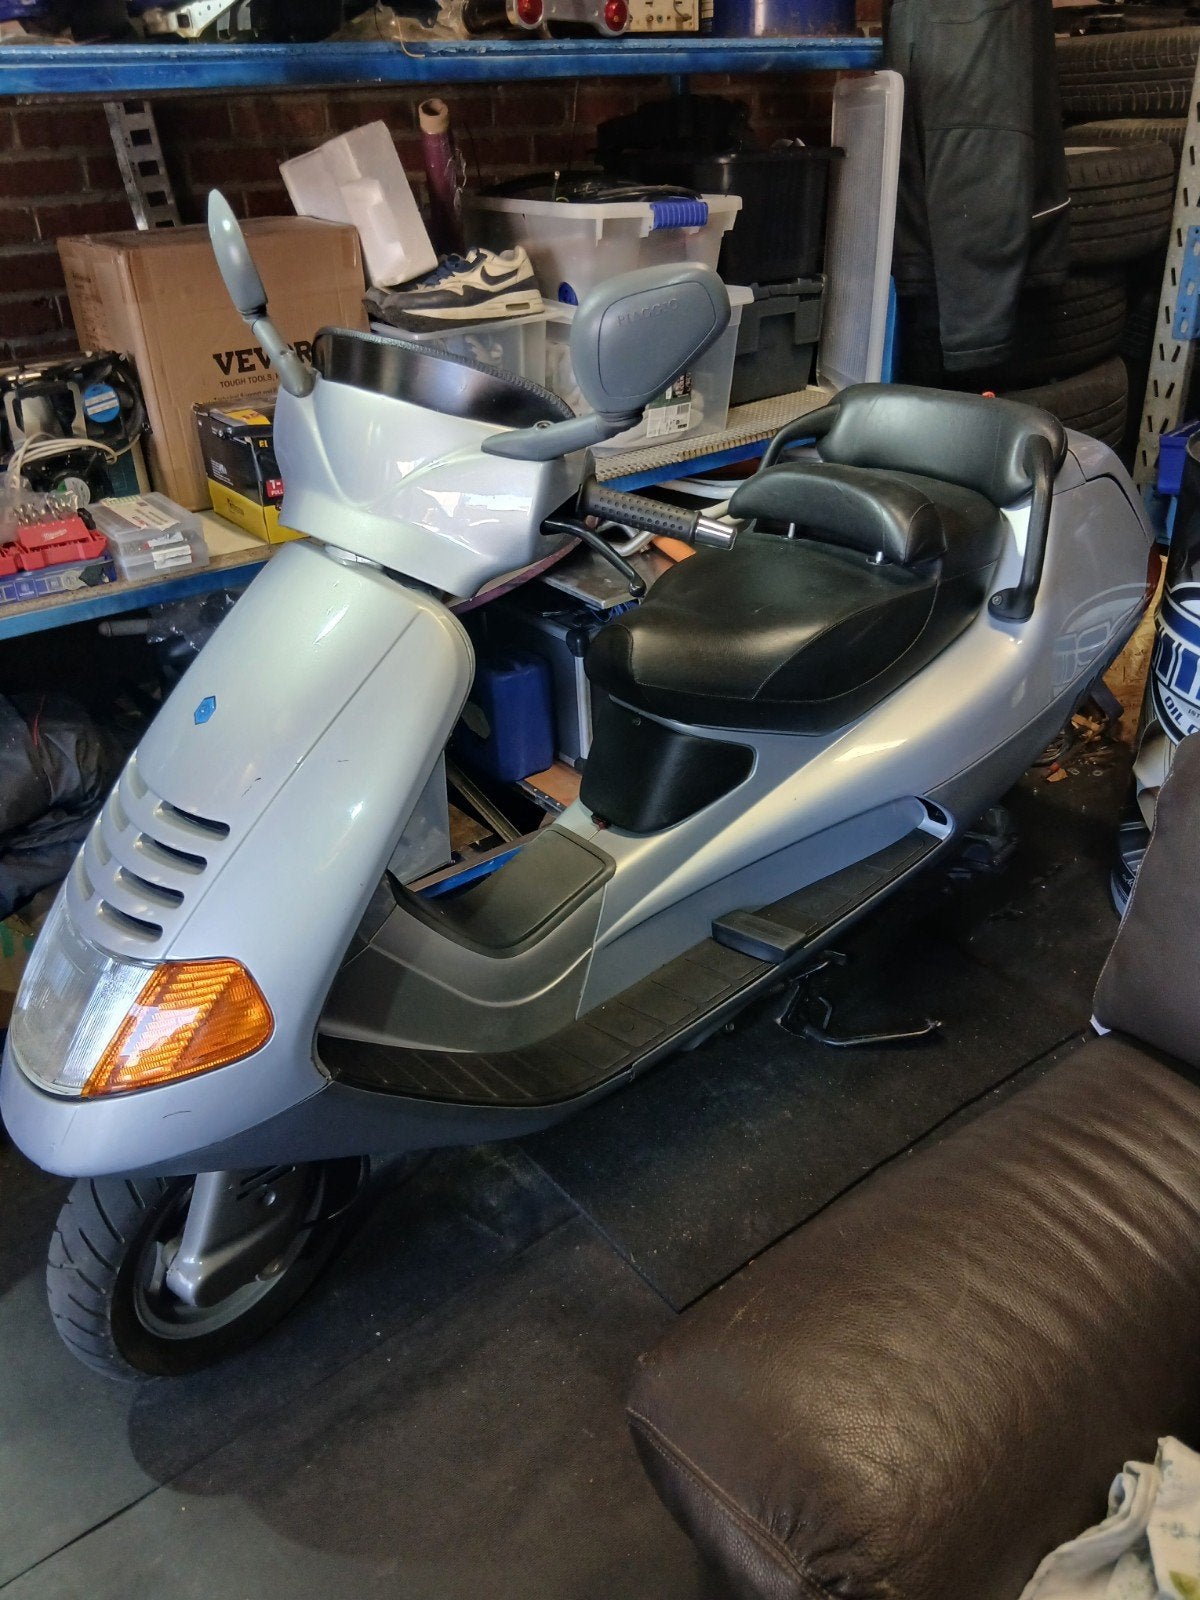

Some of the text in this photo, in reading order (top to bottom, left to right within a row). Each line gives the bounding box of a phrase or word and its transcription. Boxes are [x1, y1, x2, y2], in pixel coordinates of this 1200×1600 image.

[617, 299, 678, 325] PIAGGIO
[213, 340, 312, 375] VEVR
[219, 378, 246, 388] TOUGH
[1165, 696, 1182, 725] OIL
